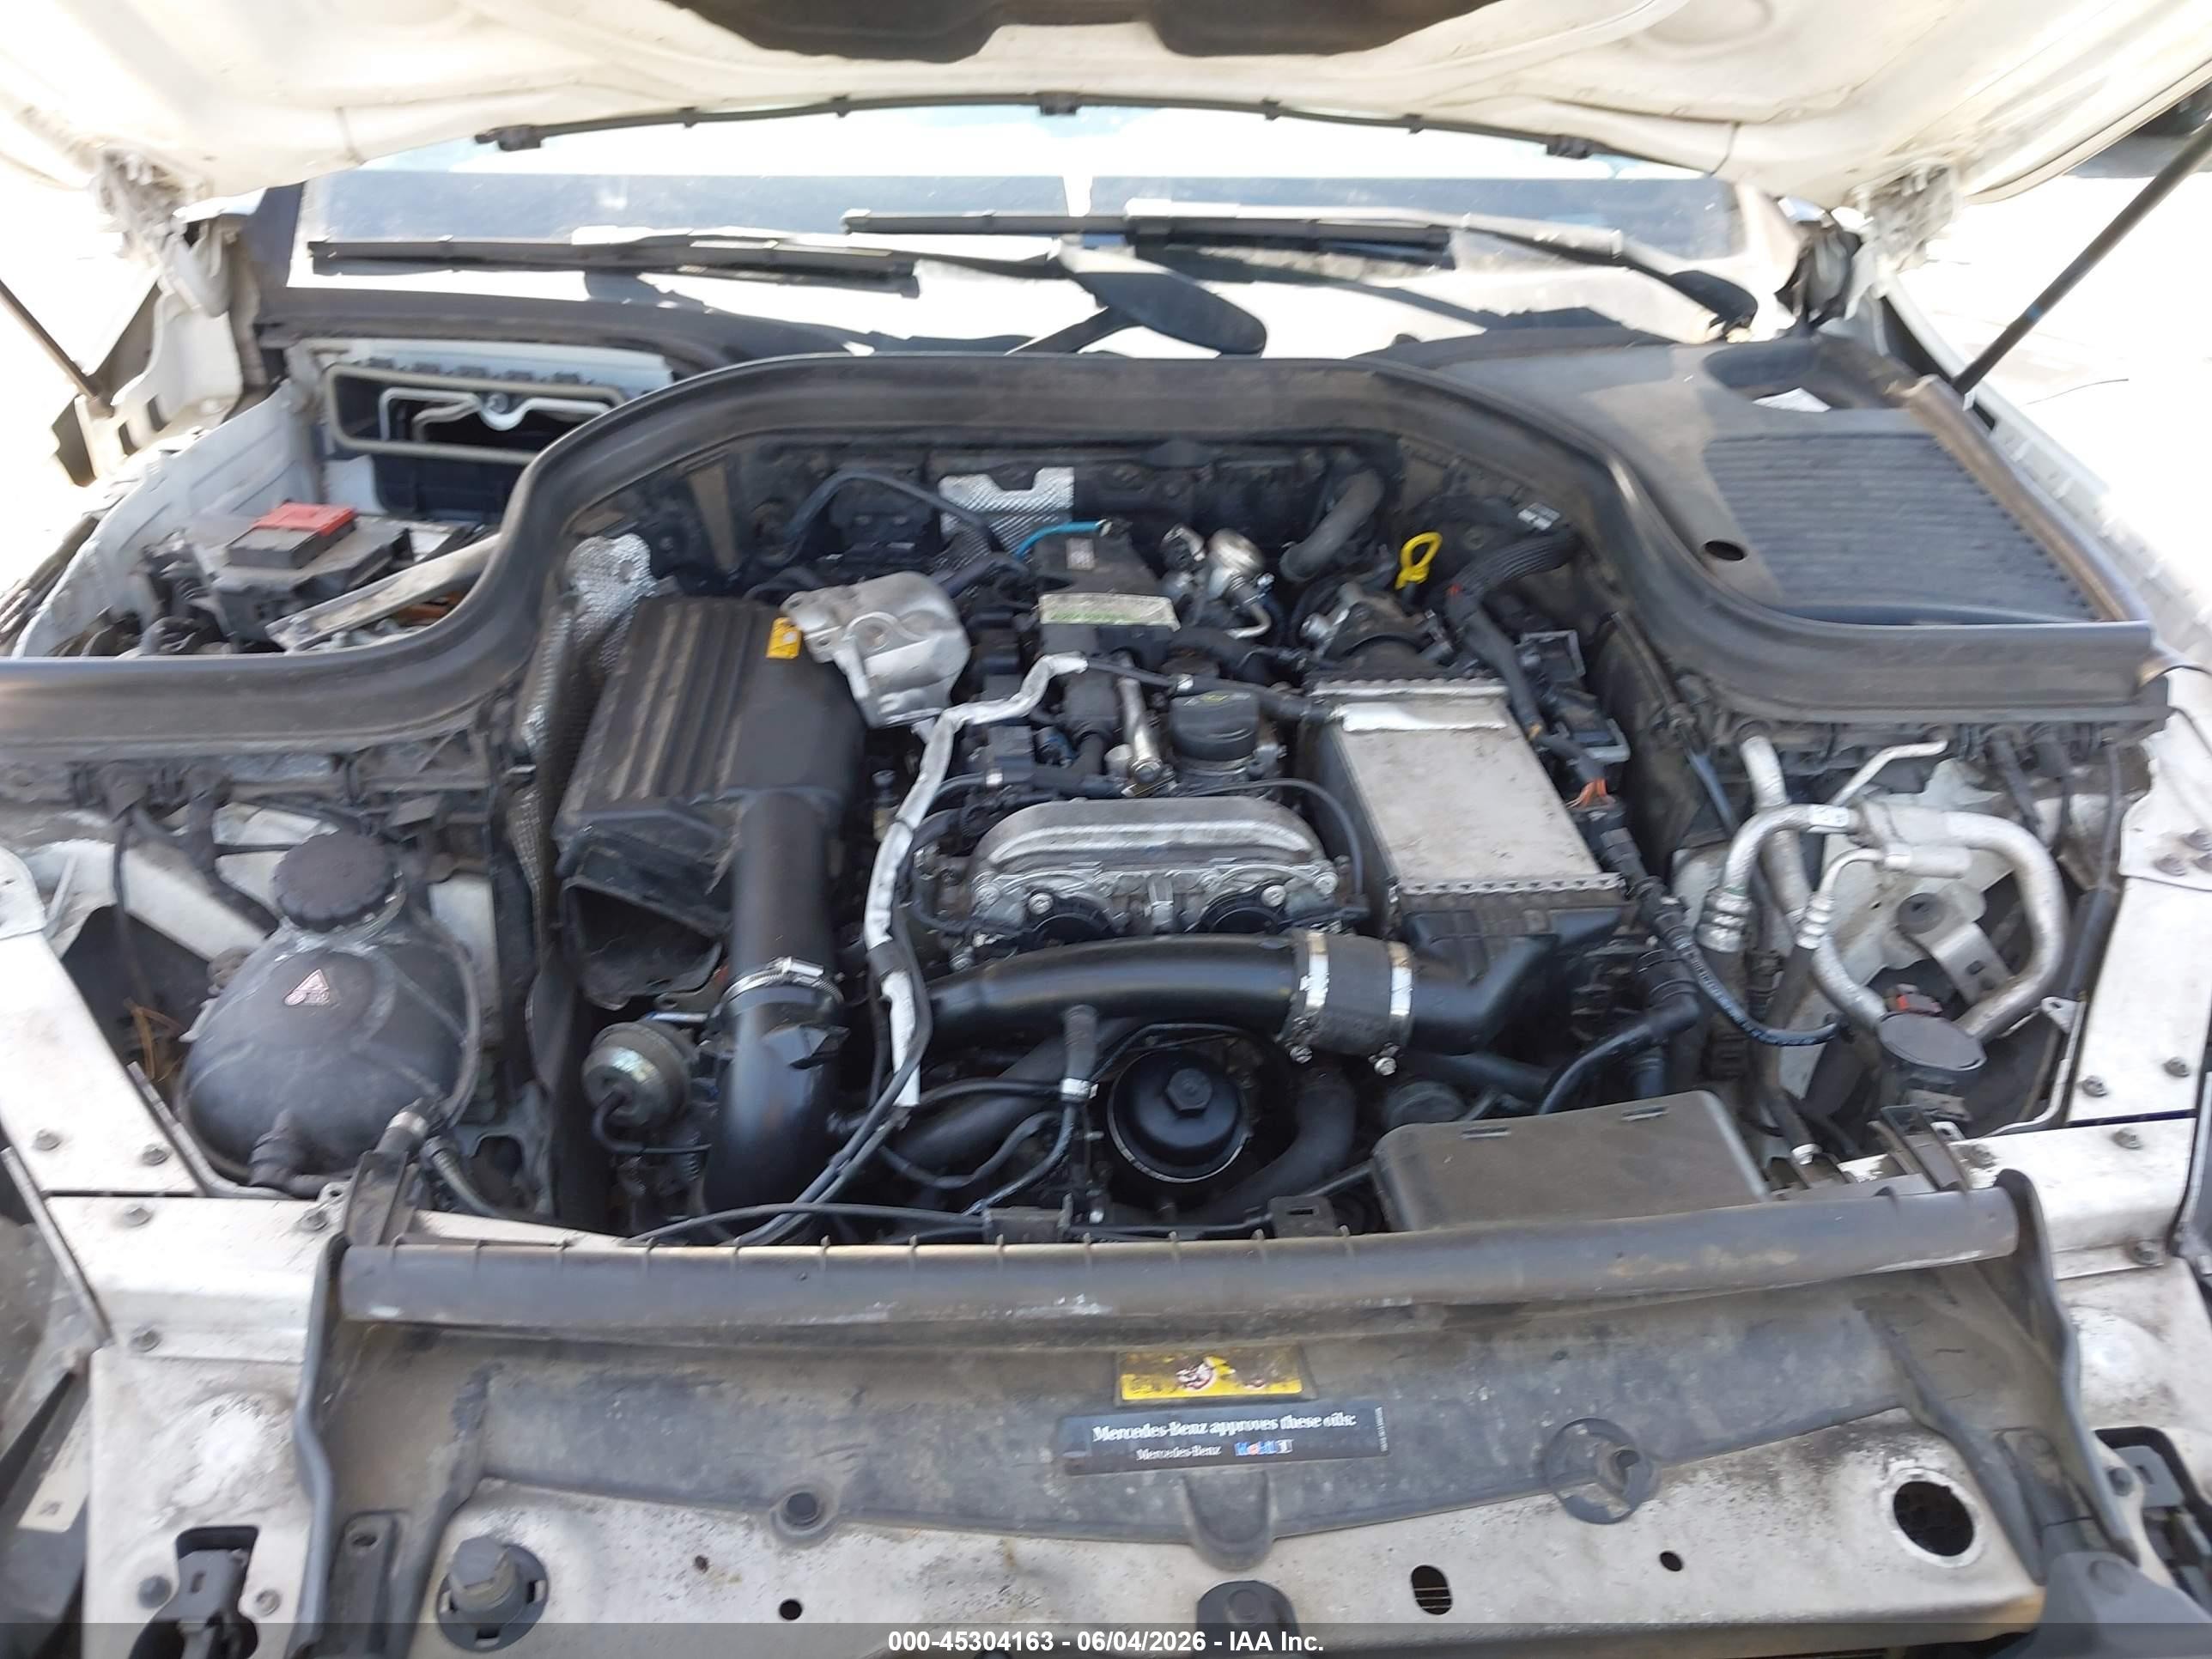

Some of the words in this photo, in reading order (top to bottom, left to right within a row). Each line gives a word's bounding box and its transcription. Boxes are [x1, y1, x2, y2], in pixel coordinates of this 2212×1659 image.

[1092, 1419, 1209, 1443] Mercedes-Benz
[1209, 1418, 1279, 1437] approves
[1280, 1414, 1322, 1430] these
[1136, 1445, 1221, 1461] Mercedes-Benz
